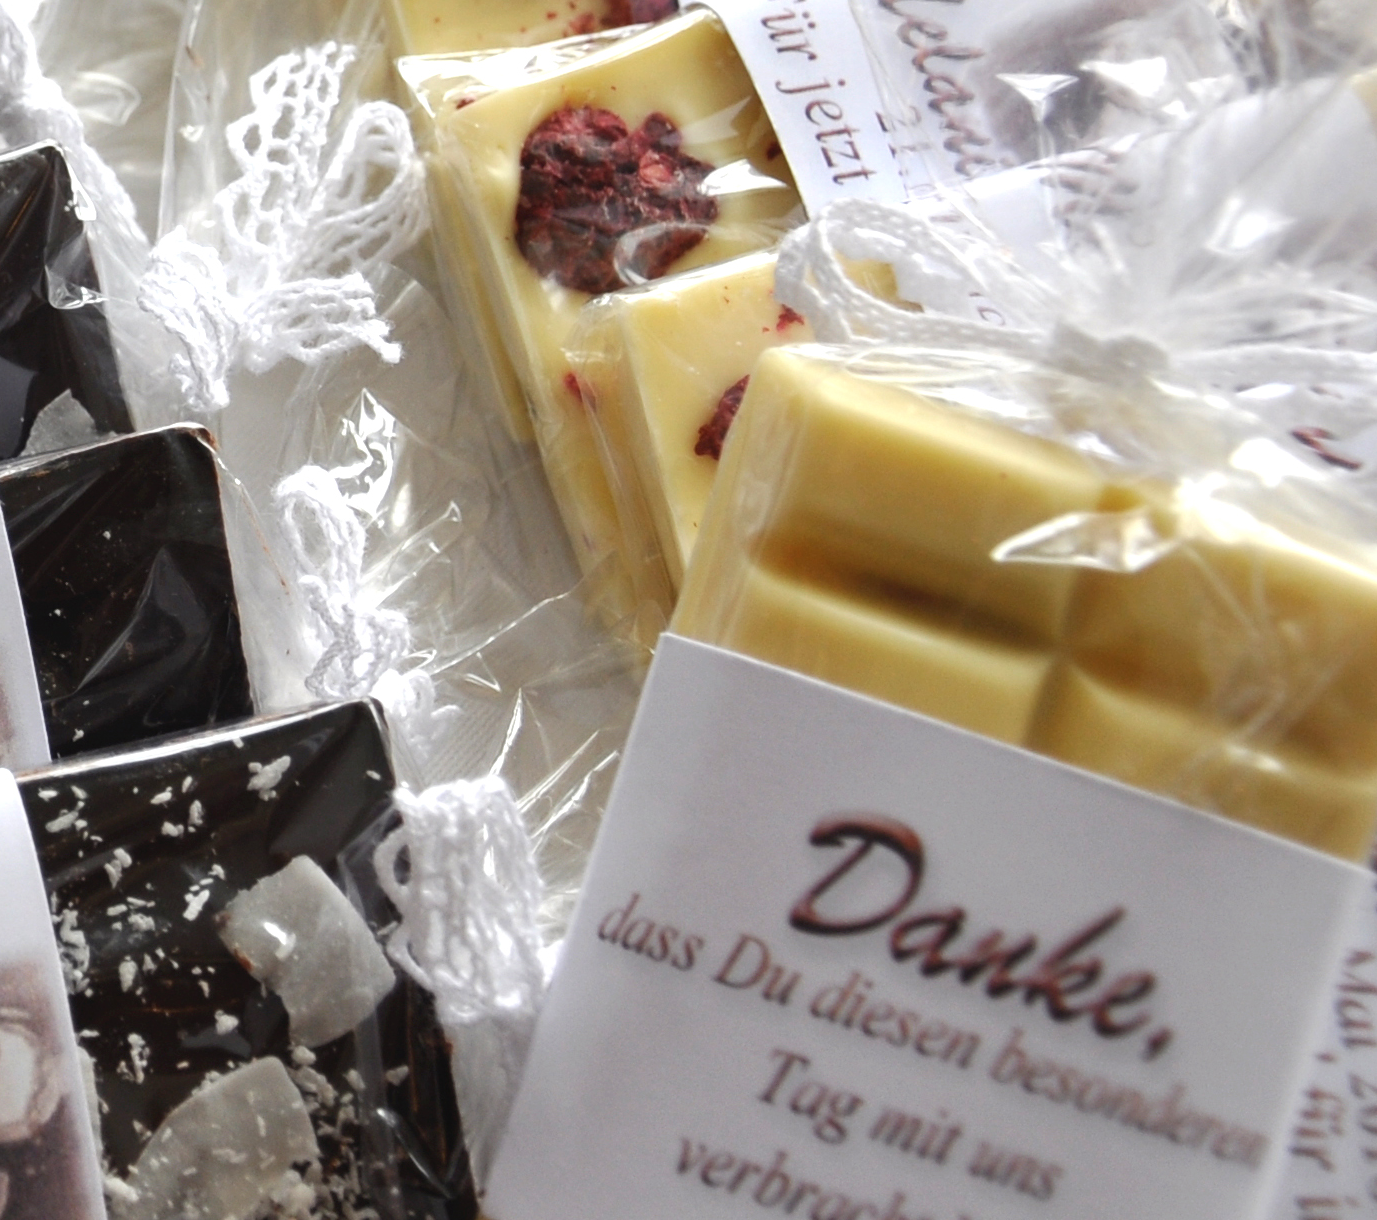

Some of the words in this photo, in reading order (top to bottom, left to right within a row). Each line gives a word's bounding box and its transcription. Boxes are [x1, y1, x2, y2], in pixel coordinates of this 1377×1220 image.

[776, 77, 877, 186] jetzt
[597, 891, 704, 971] dass
[713, 933, 801, 1006] Du
[809, 970, 981, 1069] diesen
[788, 809, 1175, 1064] Danke,
[759, 1046, 863, 1145] Tag
[868, 1107, 963, 1166] mit
[968, 1140, 1063, 1201] uns
